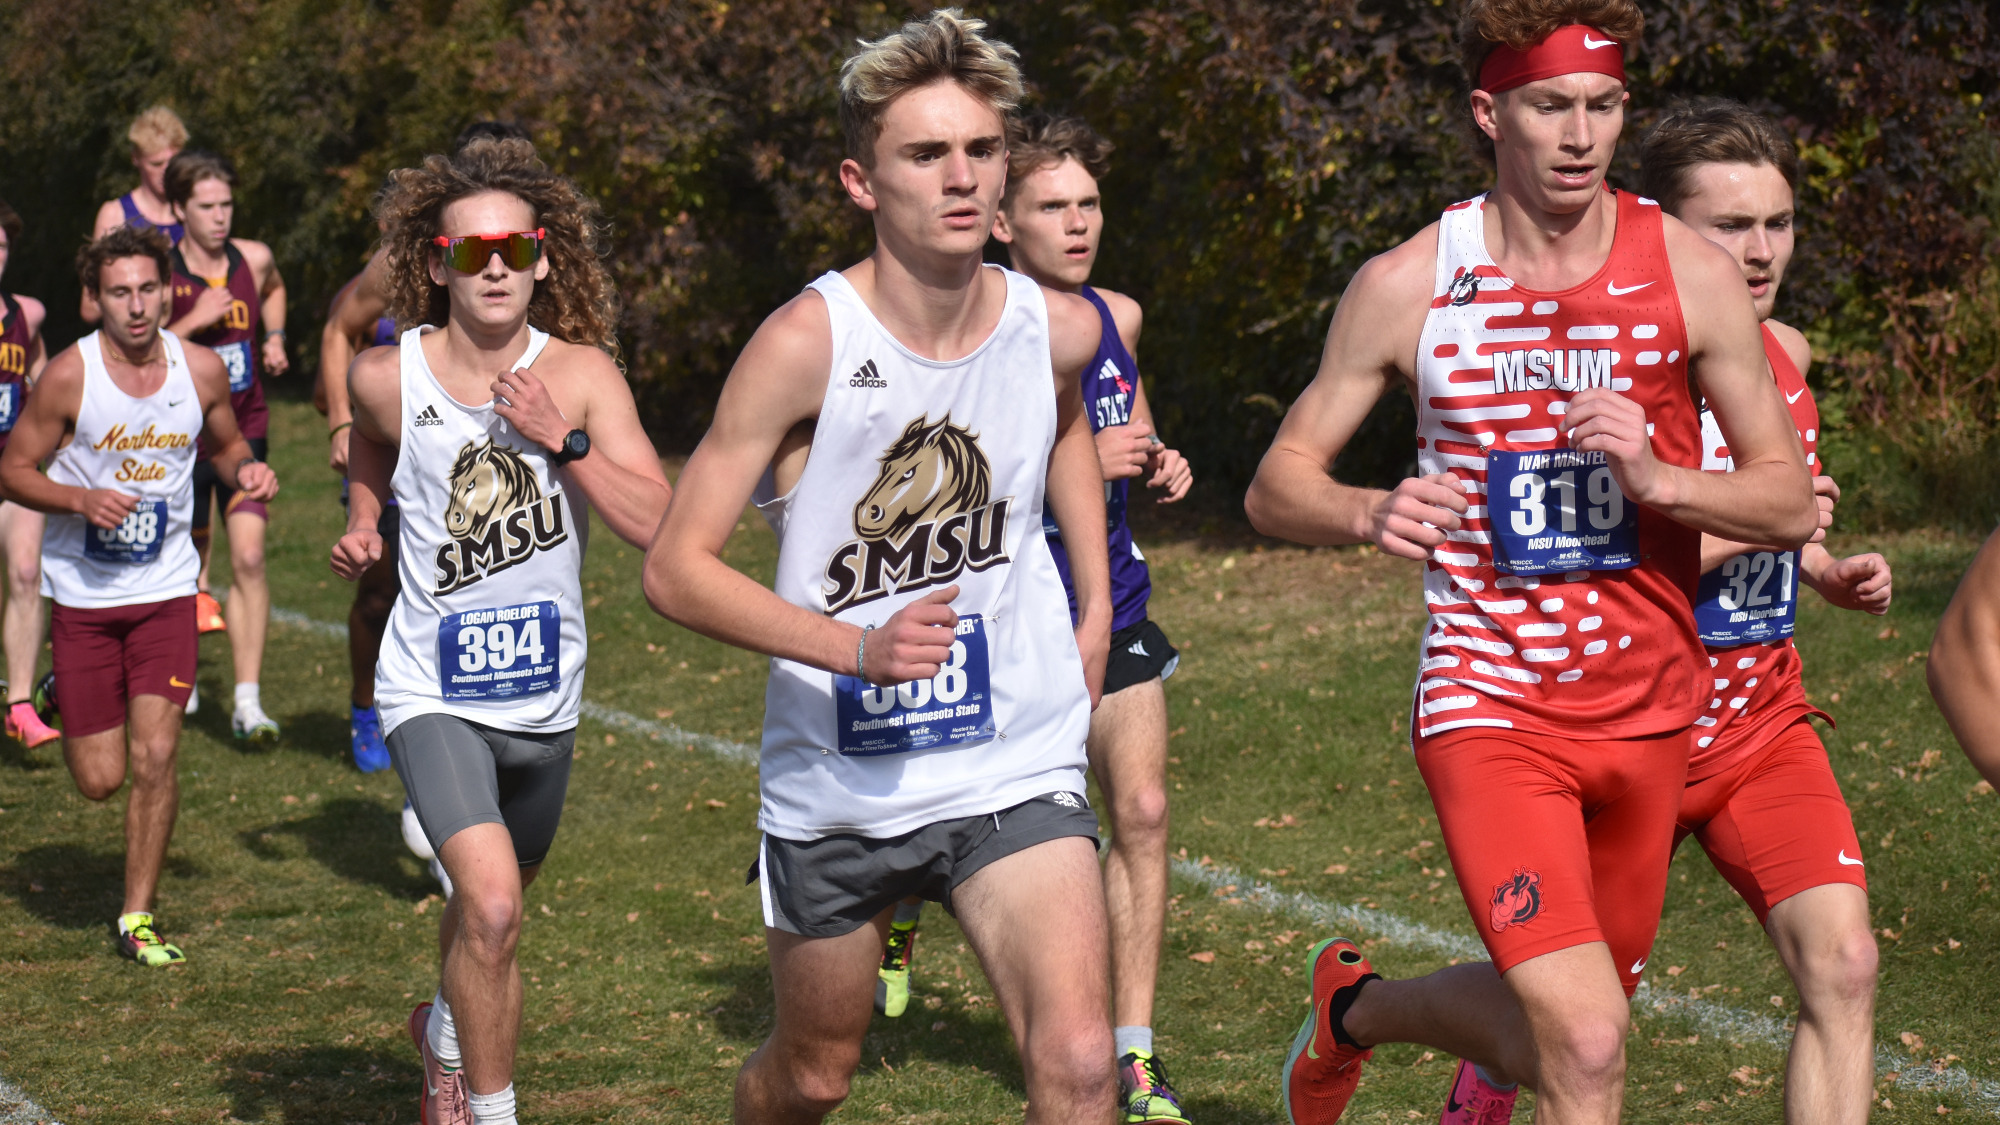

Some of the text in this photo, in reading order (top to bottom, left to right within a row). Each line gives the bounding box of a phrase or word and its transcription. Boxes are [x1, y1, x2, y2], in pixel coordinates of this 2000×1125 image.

[849, 376, 888, 388] adidas
[1492, 348, 1612, 394] MSUM
[414, 417, 444, 427] adidas
[1096, 393, 1129, 428] STATE
[93, 423, 191, 452] Northern
[115, 458, 166, 482] State
[1518, 454, 1551, 471] IVAR
[1509, 467, 1624, 536] 319
[434, 489, 568, 597] SMSU
[1528, 533, 1611, 550] MSU Moorhead
[820, 496, 1015, 617] SMSU
[1718, 550, 1794, 611] 321
[460, 605, 540, 626] LOGAN ROELOFS
[1729, 605, 1788, 623] MSU Moorhead
[457, 619, 545, 673] 394
[451, 665, 553, 684] Southwest Minnesota State
[852, 704, 980, 732] Southwest Minnesota State
